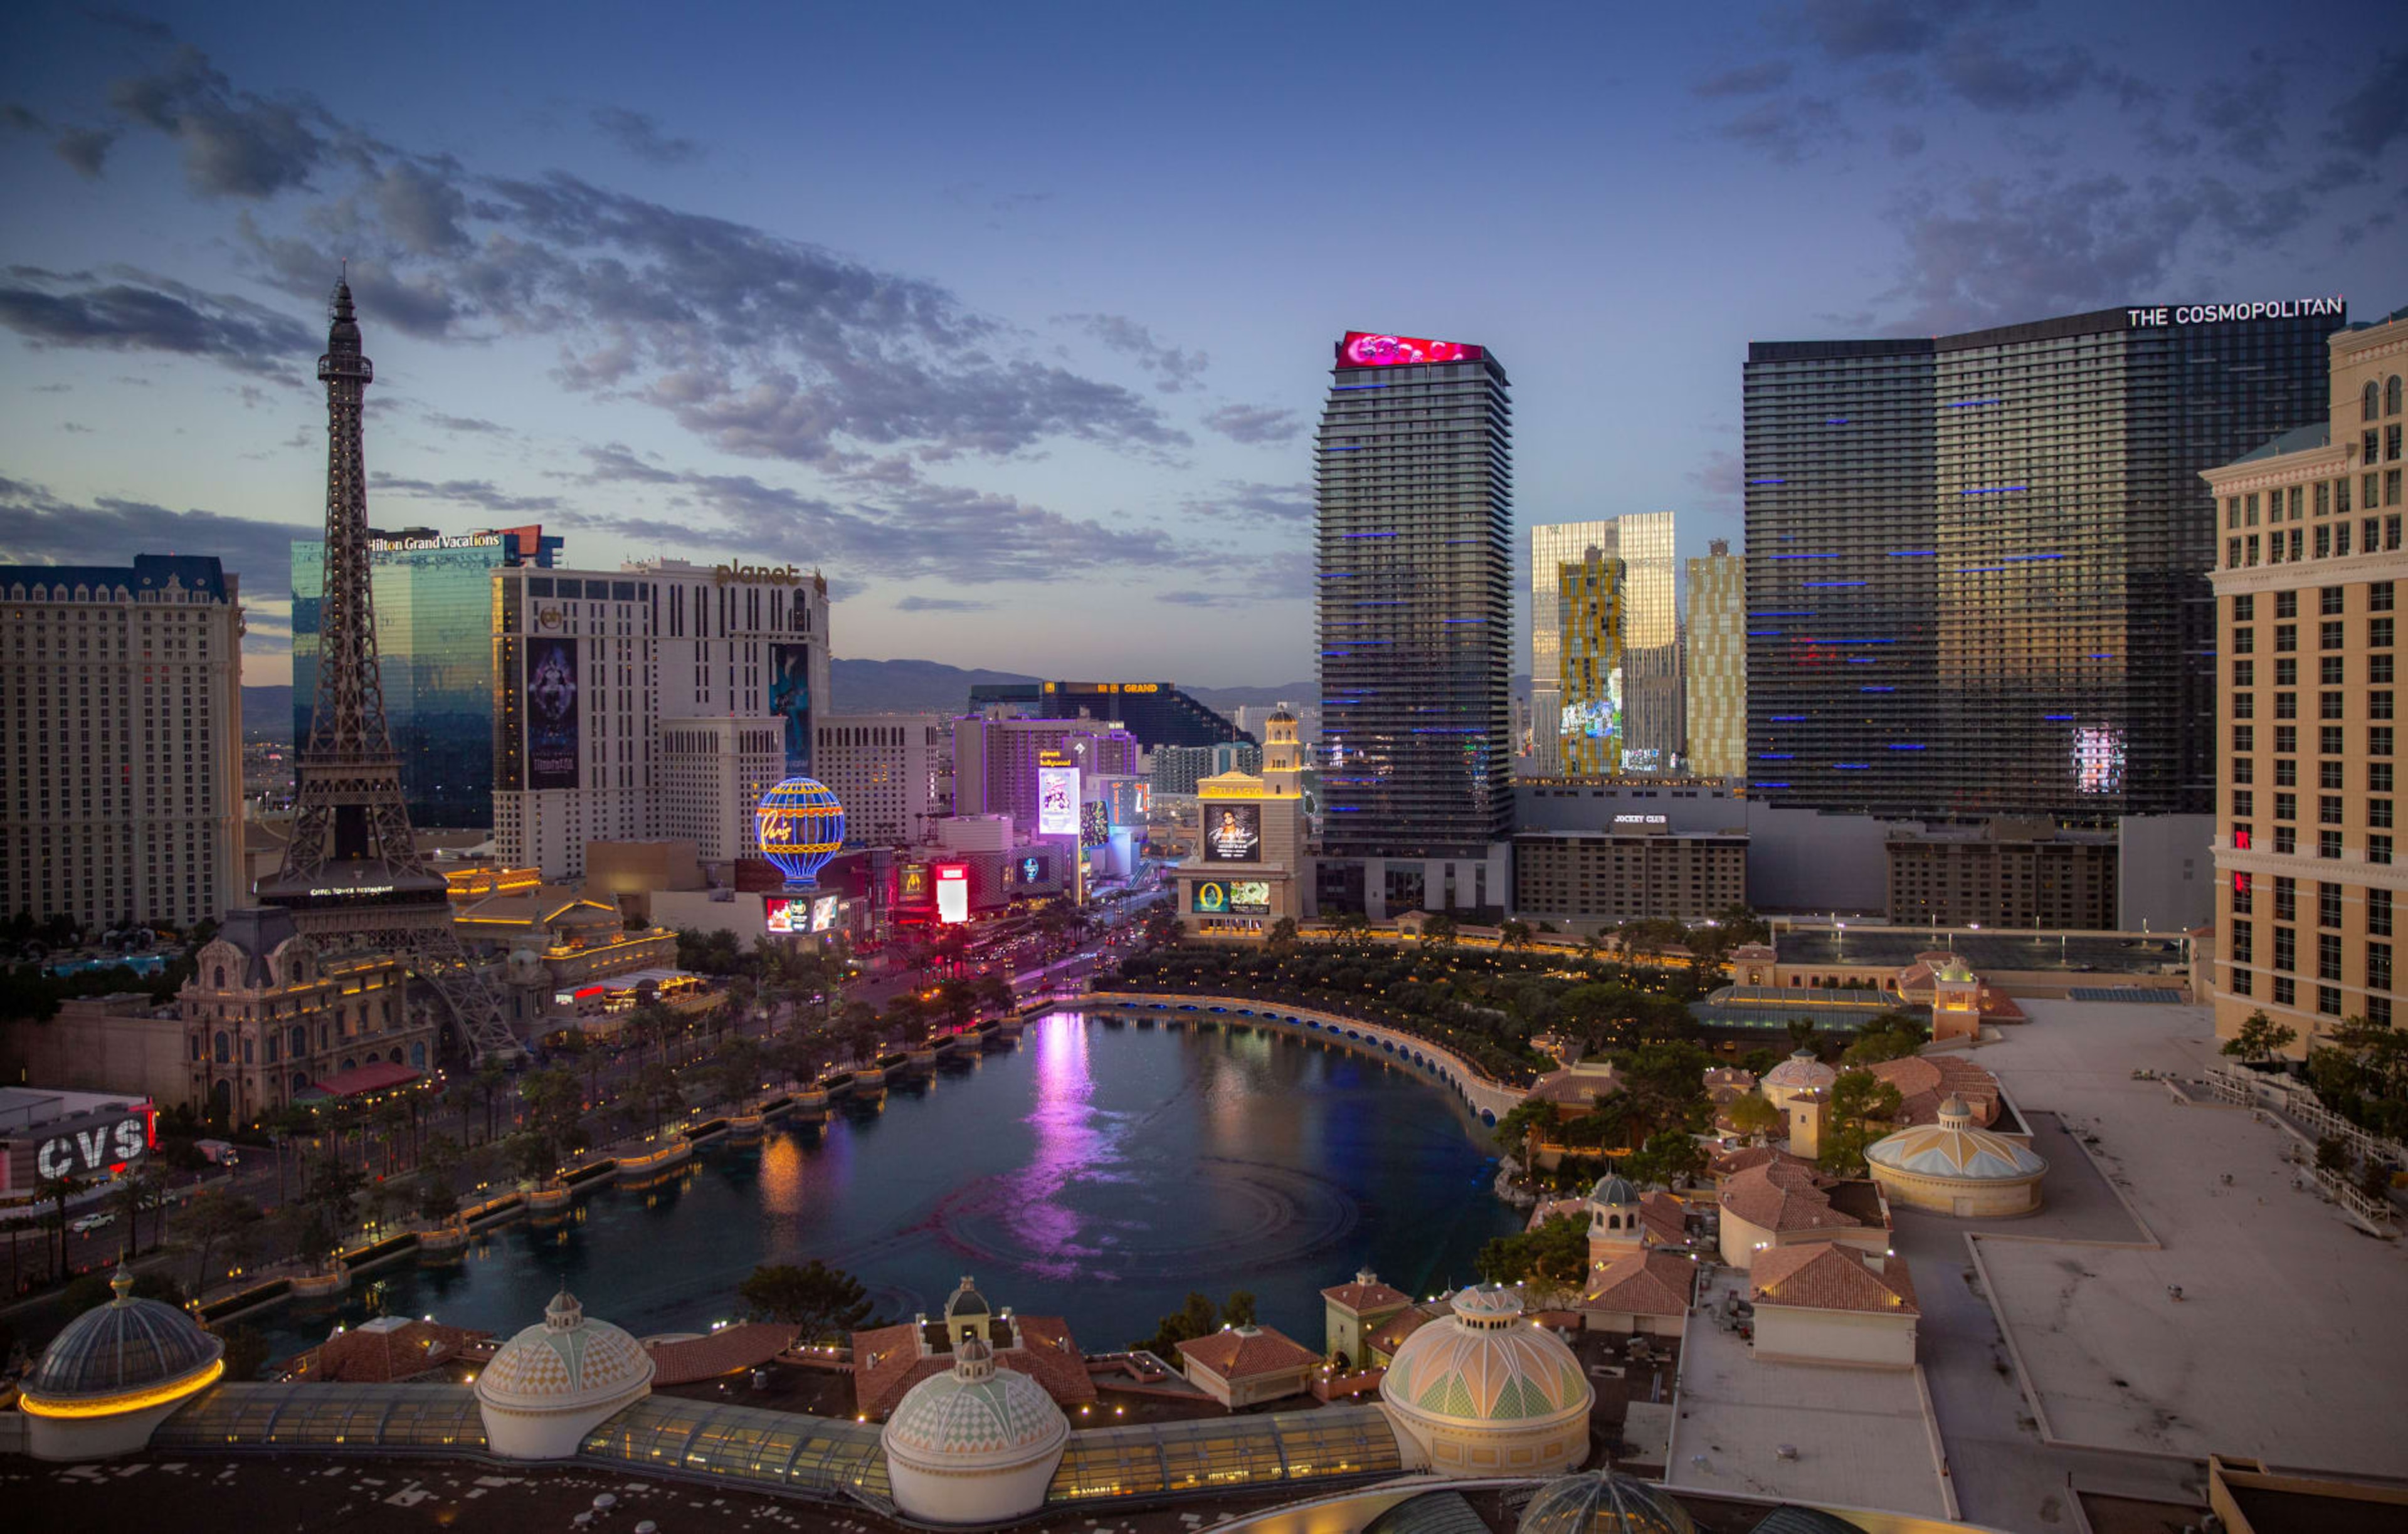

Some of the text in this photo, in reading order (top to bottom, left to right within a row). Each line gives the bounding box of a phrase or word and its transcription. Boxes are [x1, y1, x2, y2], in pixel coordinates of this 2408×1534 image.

[2128, 297, 2343, 327] THE COSMOPOLITAN
[367, 534, 500, 552] Hilton Grand Vacations
[717, 558, 801, 588] planet
[1124, 683, 1158, 693] GRAND
[761, 810, 791, 850] Paris
[1614, 815, 1667, 824] JOCKEY CLUB
[38, 1119, 144, 1179] CVS
